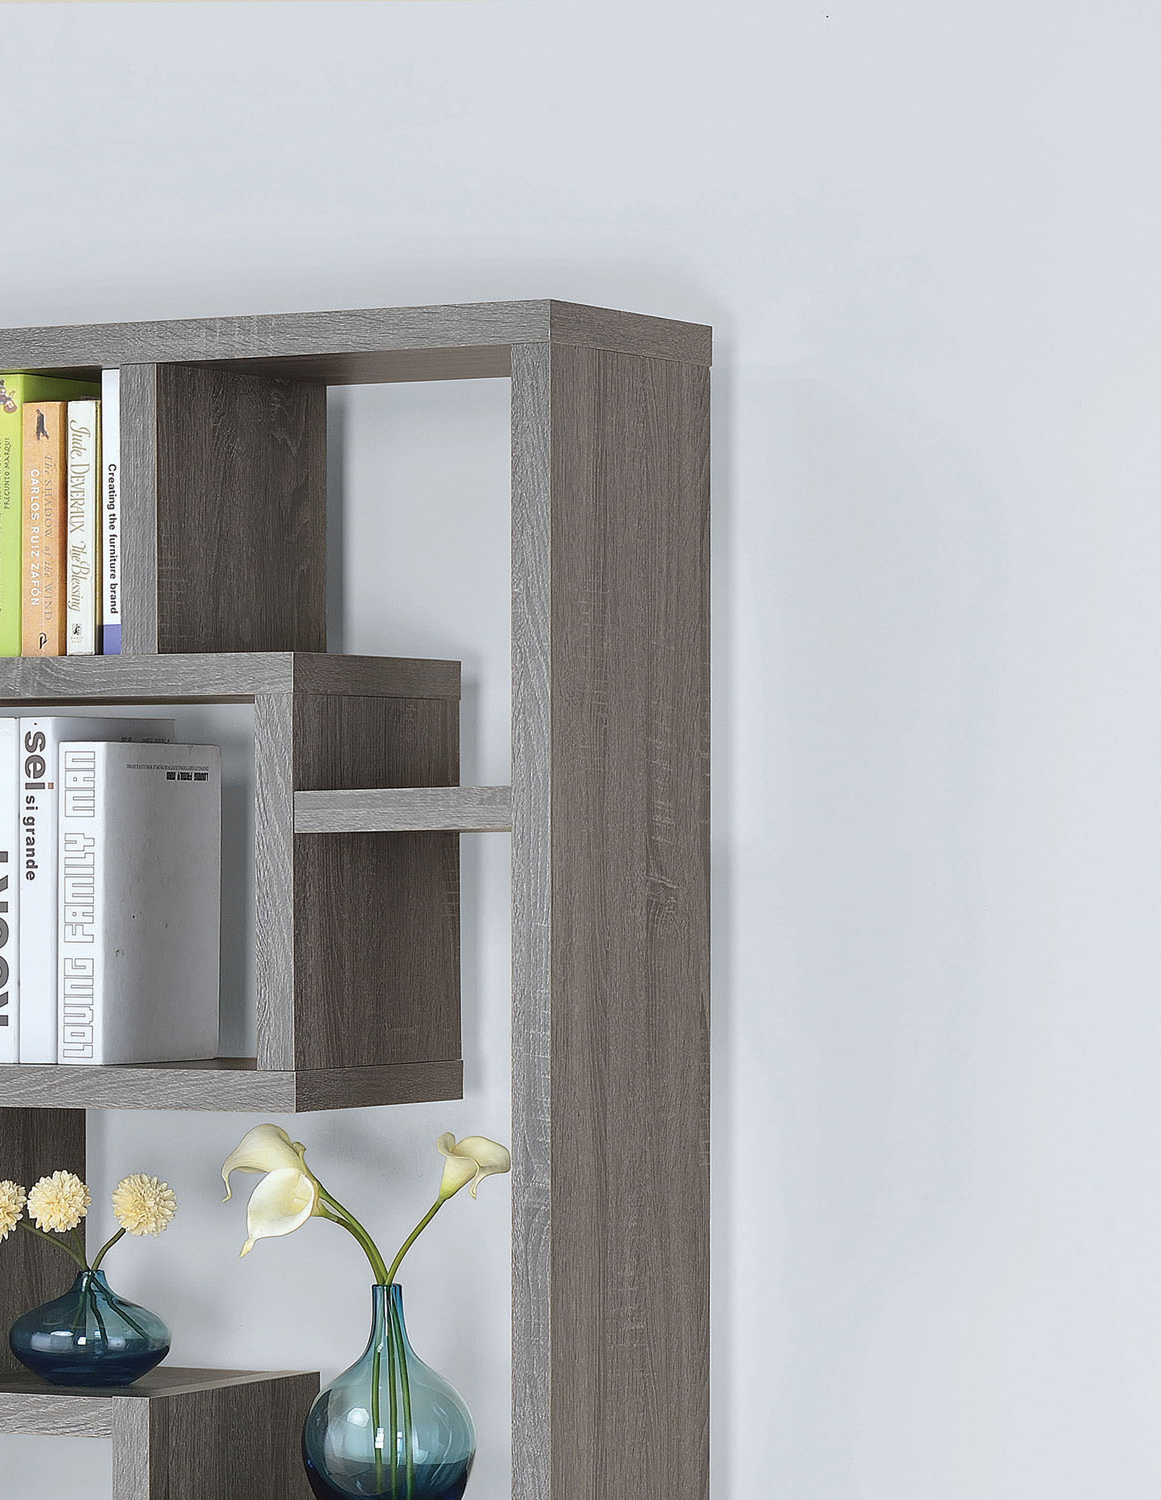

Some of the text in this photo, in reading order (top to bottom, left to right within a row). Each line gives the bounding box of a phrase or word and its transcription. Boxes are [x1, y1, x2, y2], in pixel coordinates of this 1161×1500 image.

[69, 419, 91, 460] Jude
[30, 469, 42, 606] CARLOS RUIZ ZAFÓN
[42, 455, 54, 621] The SHADOW of the WIND
[107, 463, 119, 614] Creating the furniture brand
[23, 731, 54, 881] sei si grande
[64, 751, 95, 818] MAN
[64, 832, 95, 944] FAMILY
